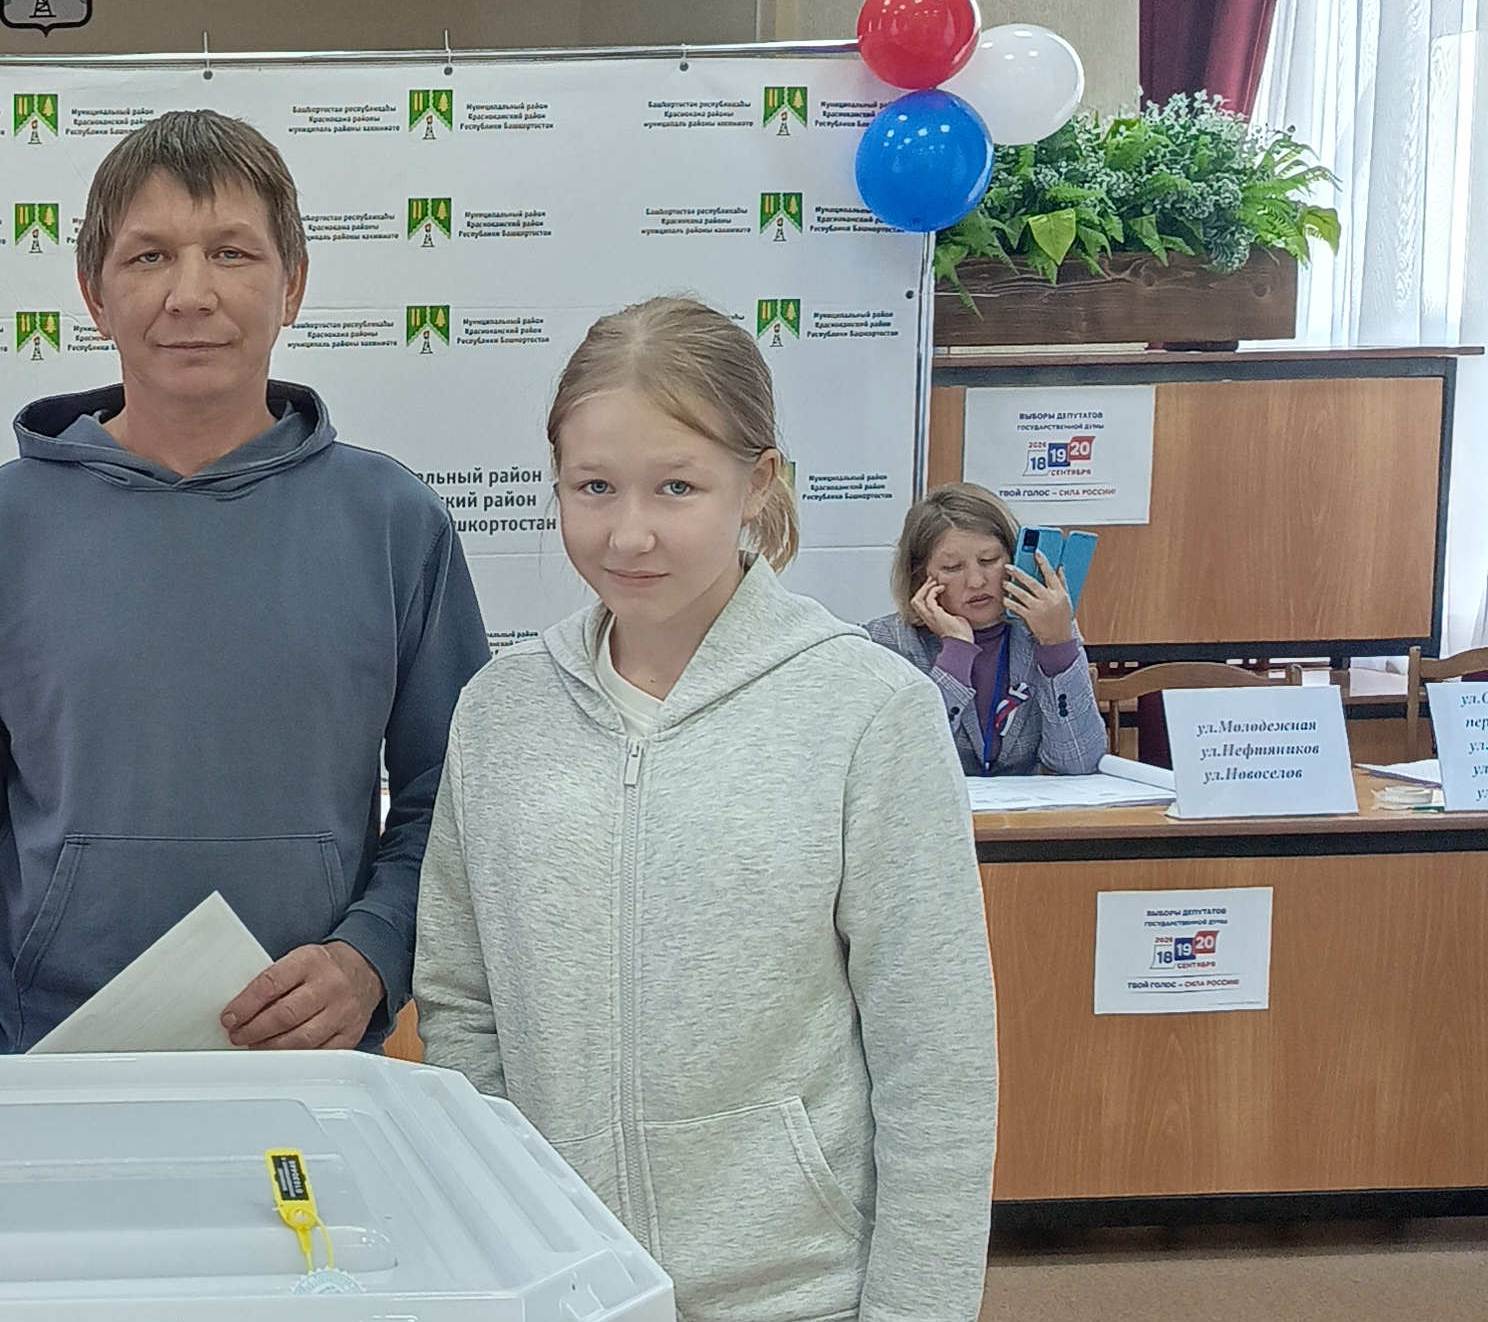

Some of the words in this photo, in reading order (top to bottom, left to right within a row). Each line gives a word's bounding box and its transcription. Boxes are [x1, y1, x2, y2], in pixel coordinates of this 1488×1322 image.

[1030, 457, 1046, 470] 18
[1050, 449, 1066, 462] 19
[1070, 442, 1090, 455] 20
[489, 467, 542, 487] район
[484, 491, 536, 511] район
[454, 518, 556, 535] шкортостан
[1157, 951, 1173, 964] 18
[1177, 943, 1191, 956] 19
[1196, 936, 1213, 949] 20
